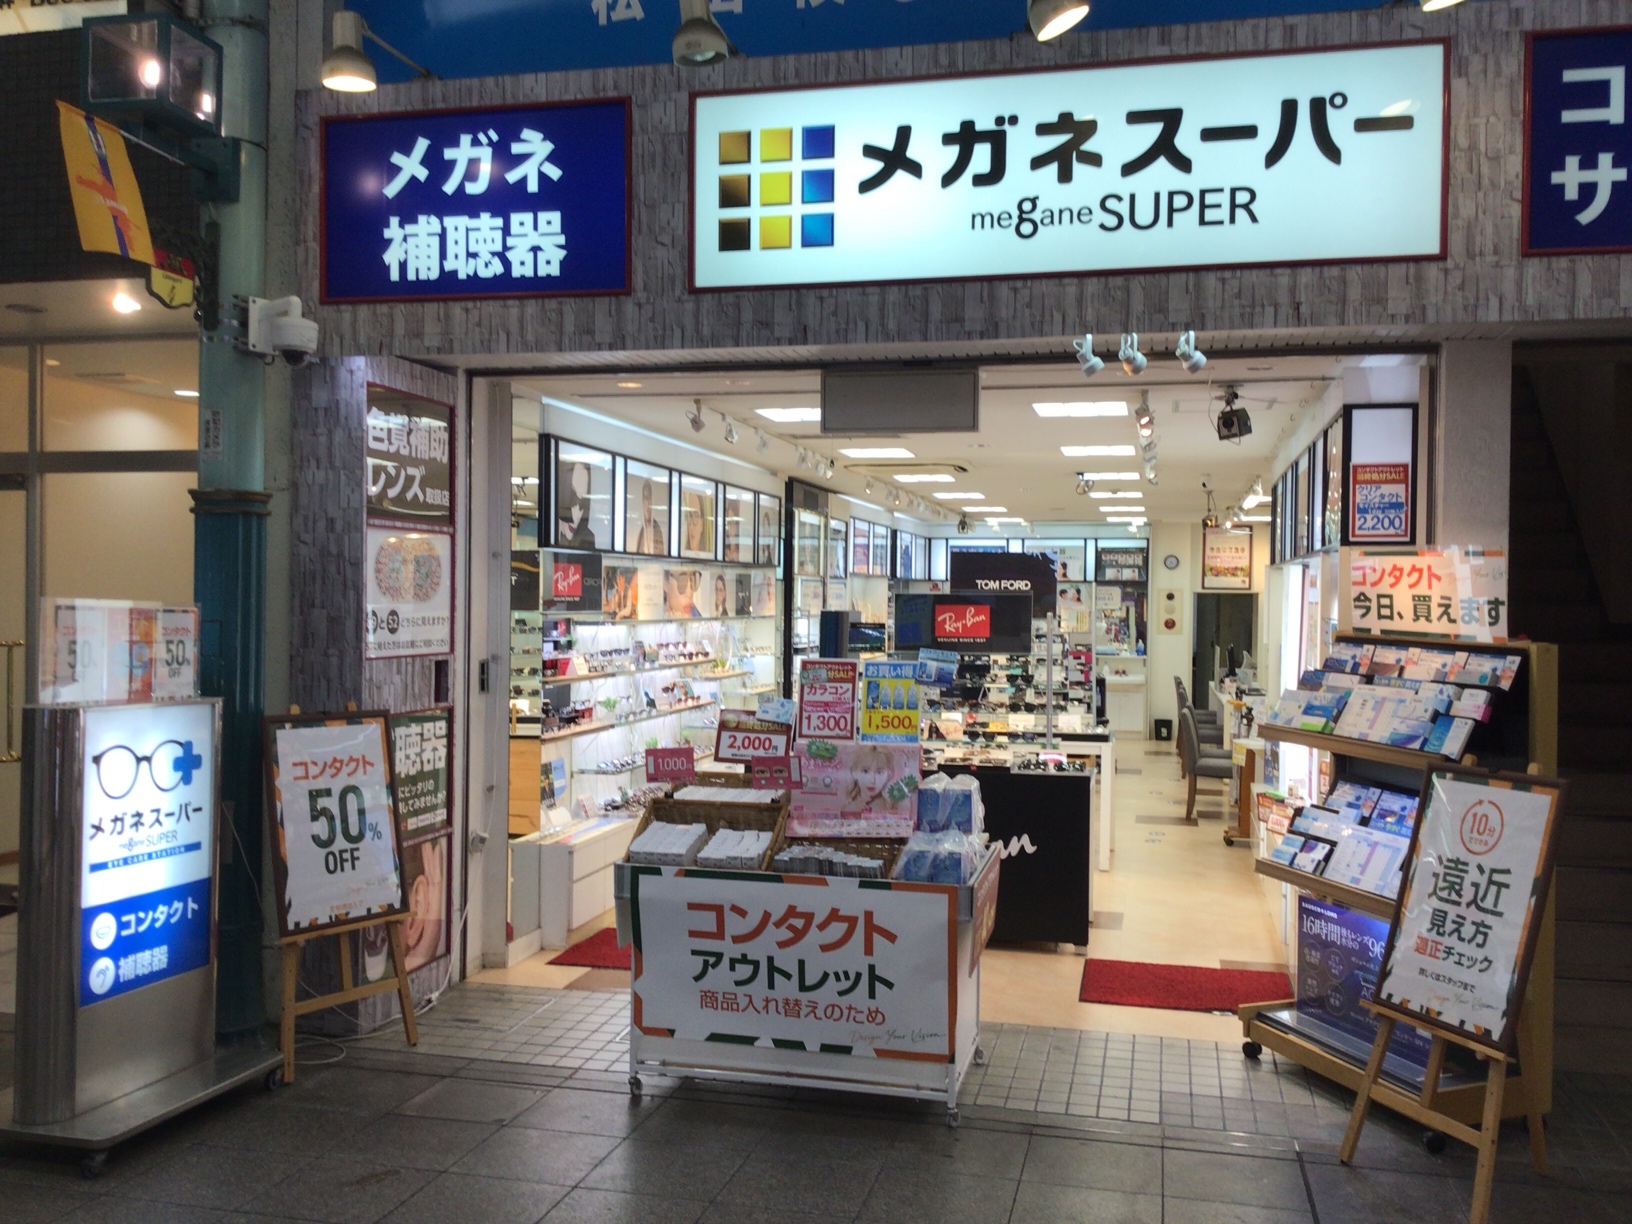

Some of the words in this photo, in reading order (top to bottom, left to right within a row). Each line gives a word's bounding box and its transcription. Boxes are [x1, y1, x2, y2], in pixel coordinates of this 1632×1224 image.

[858, 91, 1415, 194] メガネスーパー
[382, 128, 563, 200] メガネ
[382, 210, 568, 283] 補聴器
[366, 406, 449, 464] 色覚補助
[367, 459, 426, 502] レンズ
[1360, 492, 1402, 502] コンタクト
[976, 579, 999, 590] TOM
[1001, 579, 1031, 591] FORD
[1352, 563, 1442, 589] コンタクト
[1353, 592, 1505, 626] 今日、買えます
[806, 683, 850, 696] カラコン
[866, 664, 914, 679] お買い得
[391, 719, 447, 778] 聴器
[727, 733, 779, 753] 2,000円
[292, 754, 375, 781] コンタクト
[89, 801, 203, 841] メガネスーパー
[308, 784, 382, 849] 50%
[1469, 811, 1496, 838] 10分
[324, 847, 361, 875] OFF
[1428, 854, 1512, 918] 遠近
[120, 896, 199, 937] コンタクト
[686, 902, 898, 957] コンタクト
[1302, 914, 1341, 945] 16時間
[1427, 908, 1493, 948] 見え方
[118, 944, 169, 983] 補聴器
[1414, 935, 1493, 972] 適正チェック
[690, 949, 895, 1000] アウトレット
[1418, 967, 1476, 993] 詳しくはスタッフまで
[700, 989, 886, 1026] 商品入れ替えのため
[886, 1028, 905, 1045] Your
